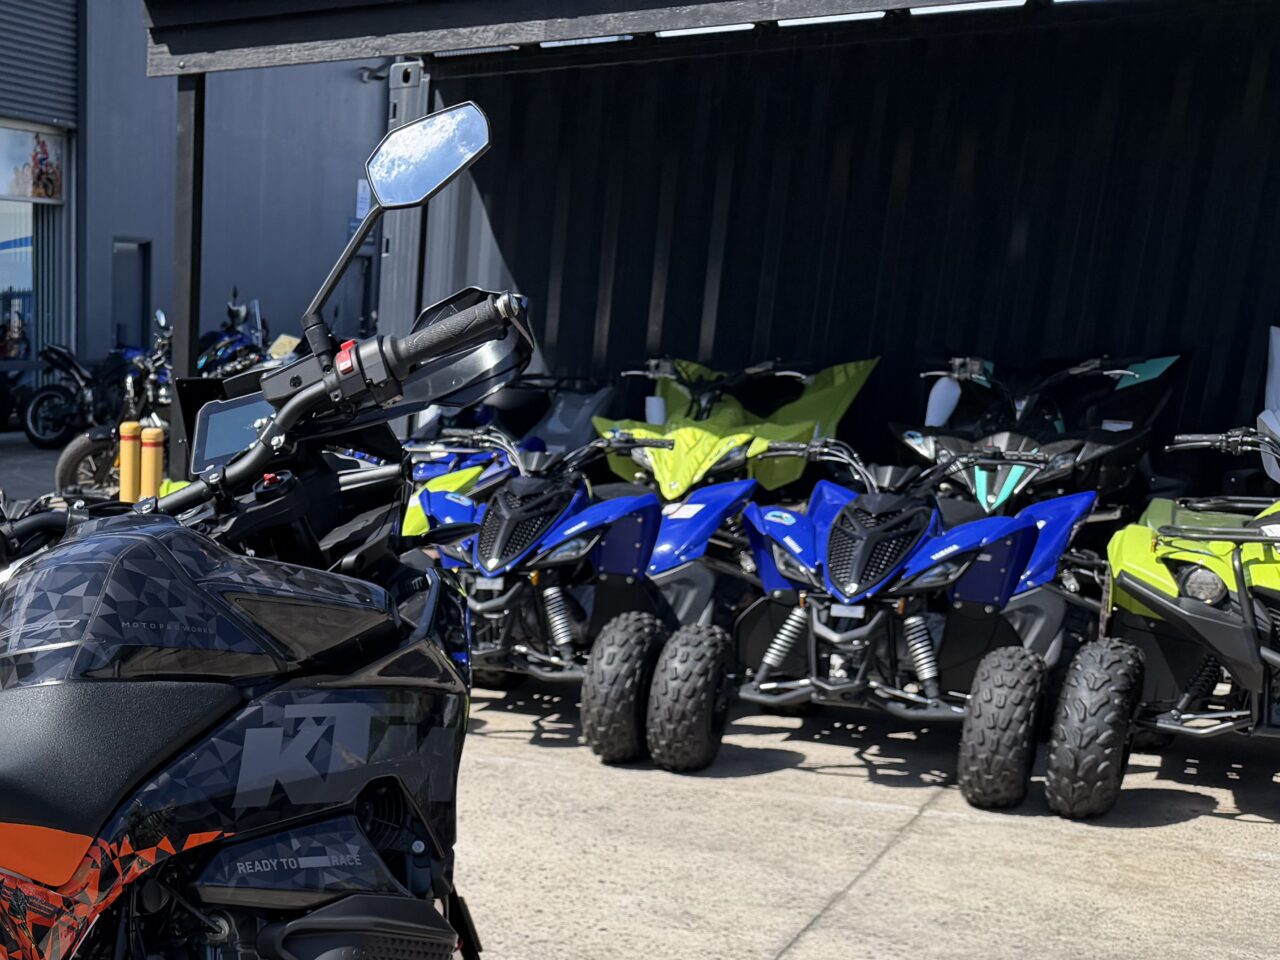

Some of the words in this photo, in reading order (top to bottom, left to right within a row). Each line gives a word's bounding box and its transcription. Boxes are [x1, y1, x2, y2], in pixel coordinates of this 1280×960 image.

[231, 702, 458, 808] KTM
[236, 858, 278, 875] READY
[280, 857, 298, 870] TO
[331, 854, 362, 867] RACE
